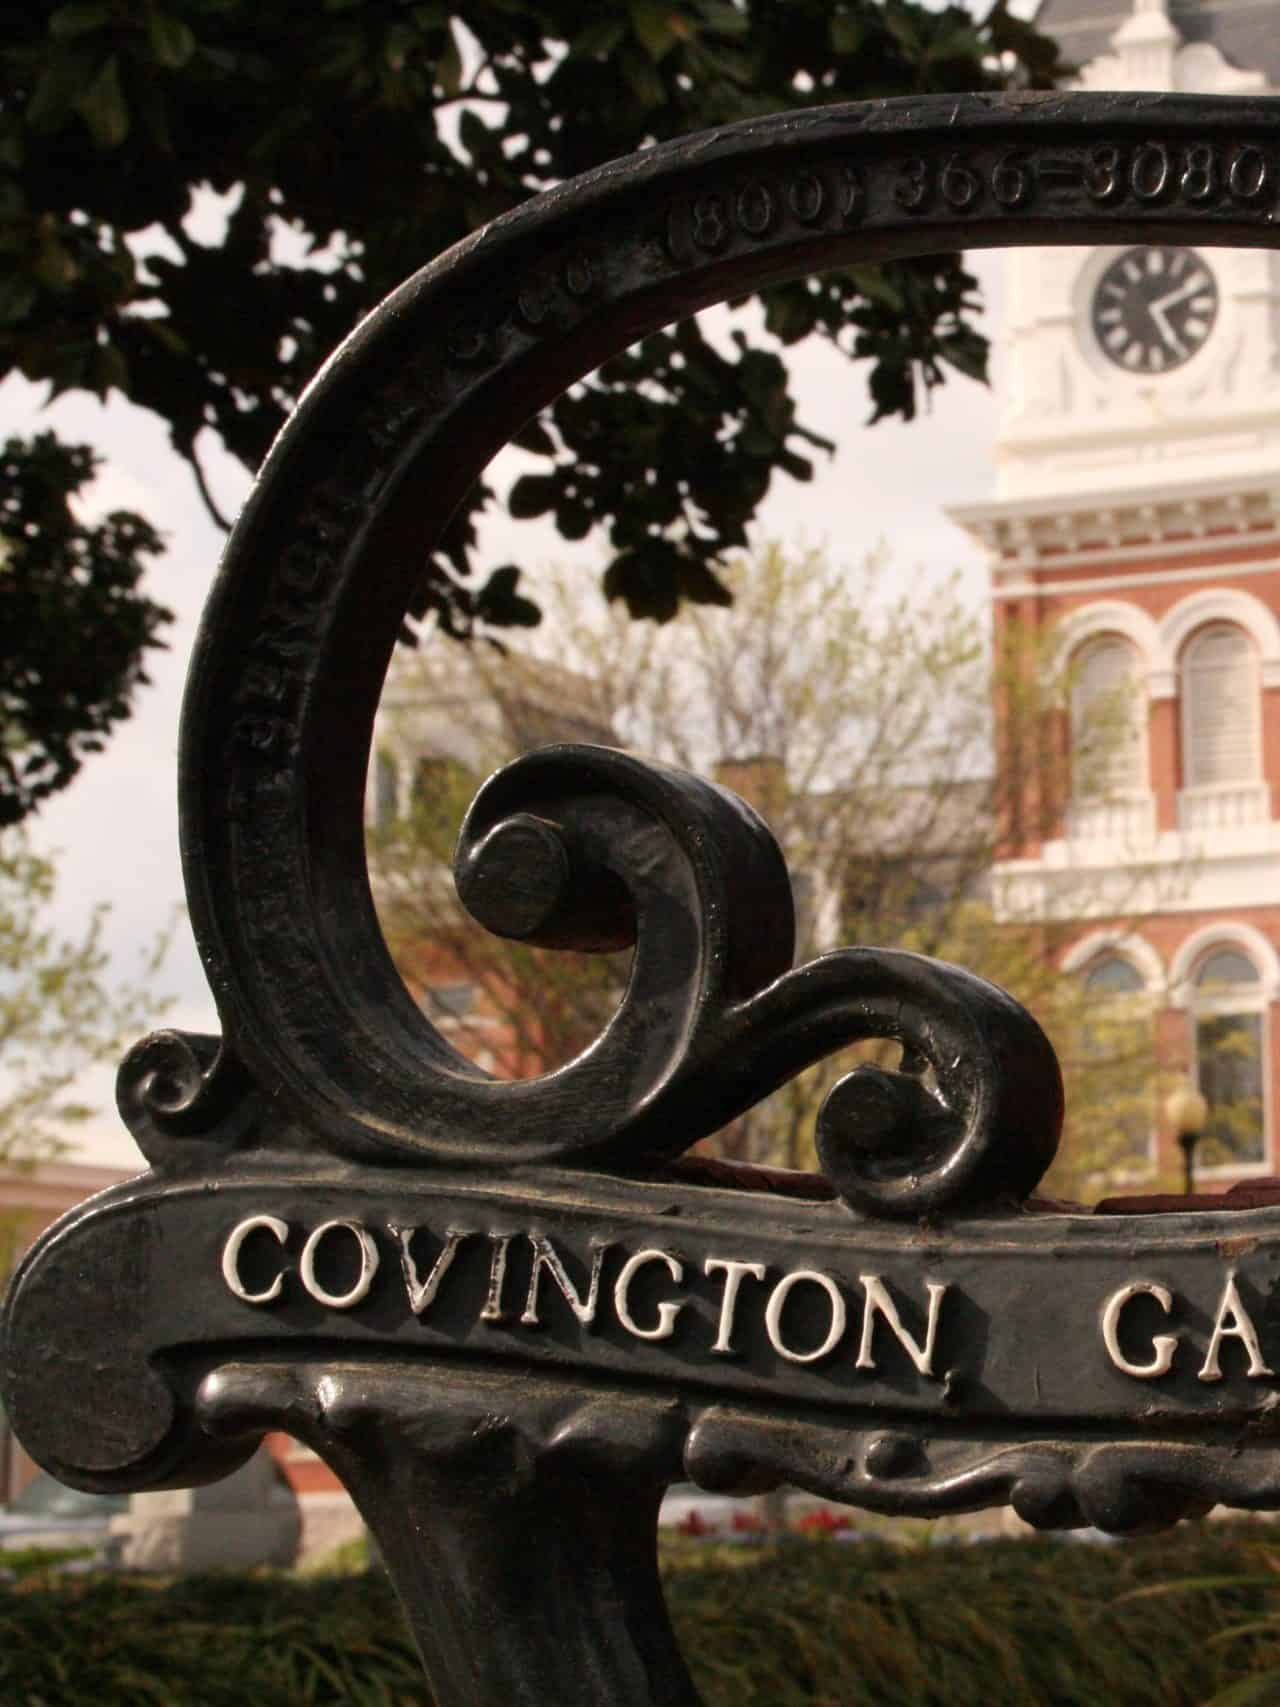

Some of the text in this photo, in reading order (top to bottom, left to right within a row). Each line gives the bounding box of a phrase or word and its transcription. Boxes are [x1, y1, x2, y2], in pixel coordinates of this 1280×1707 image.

[664, 174, 863, 257] (800)
[222, 1213, 947, 1374] COVINGTON
[1098, 1269, 1273, 1378] GA
